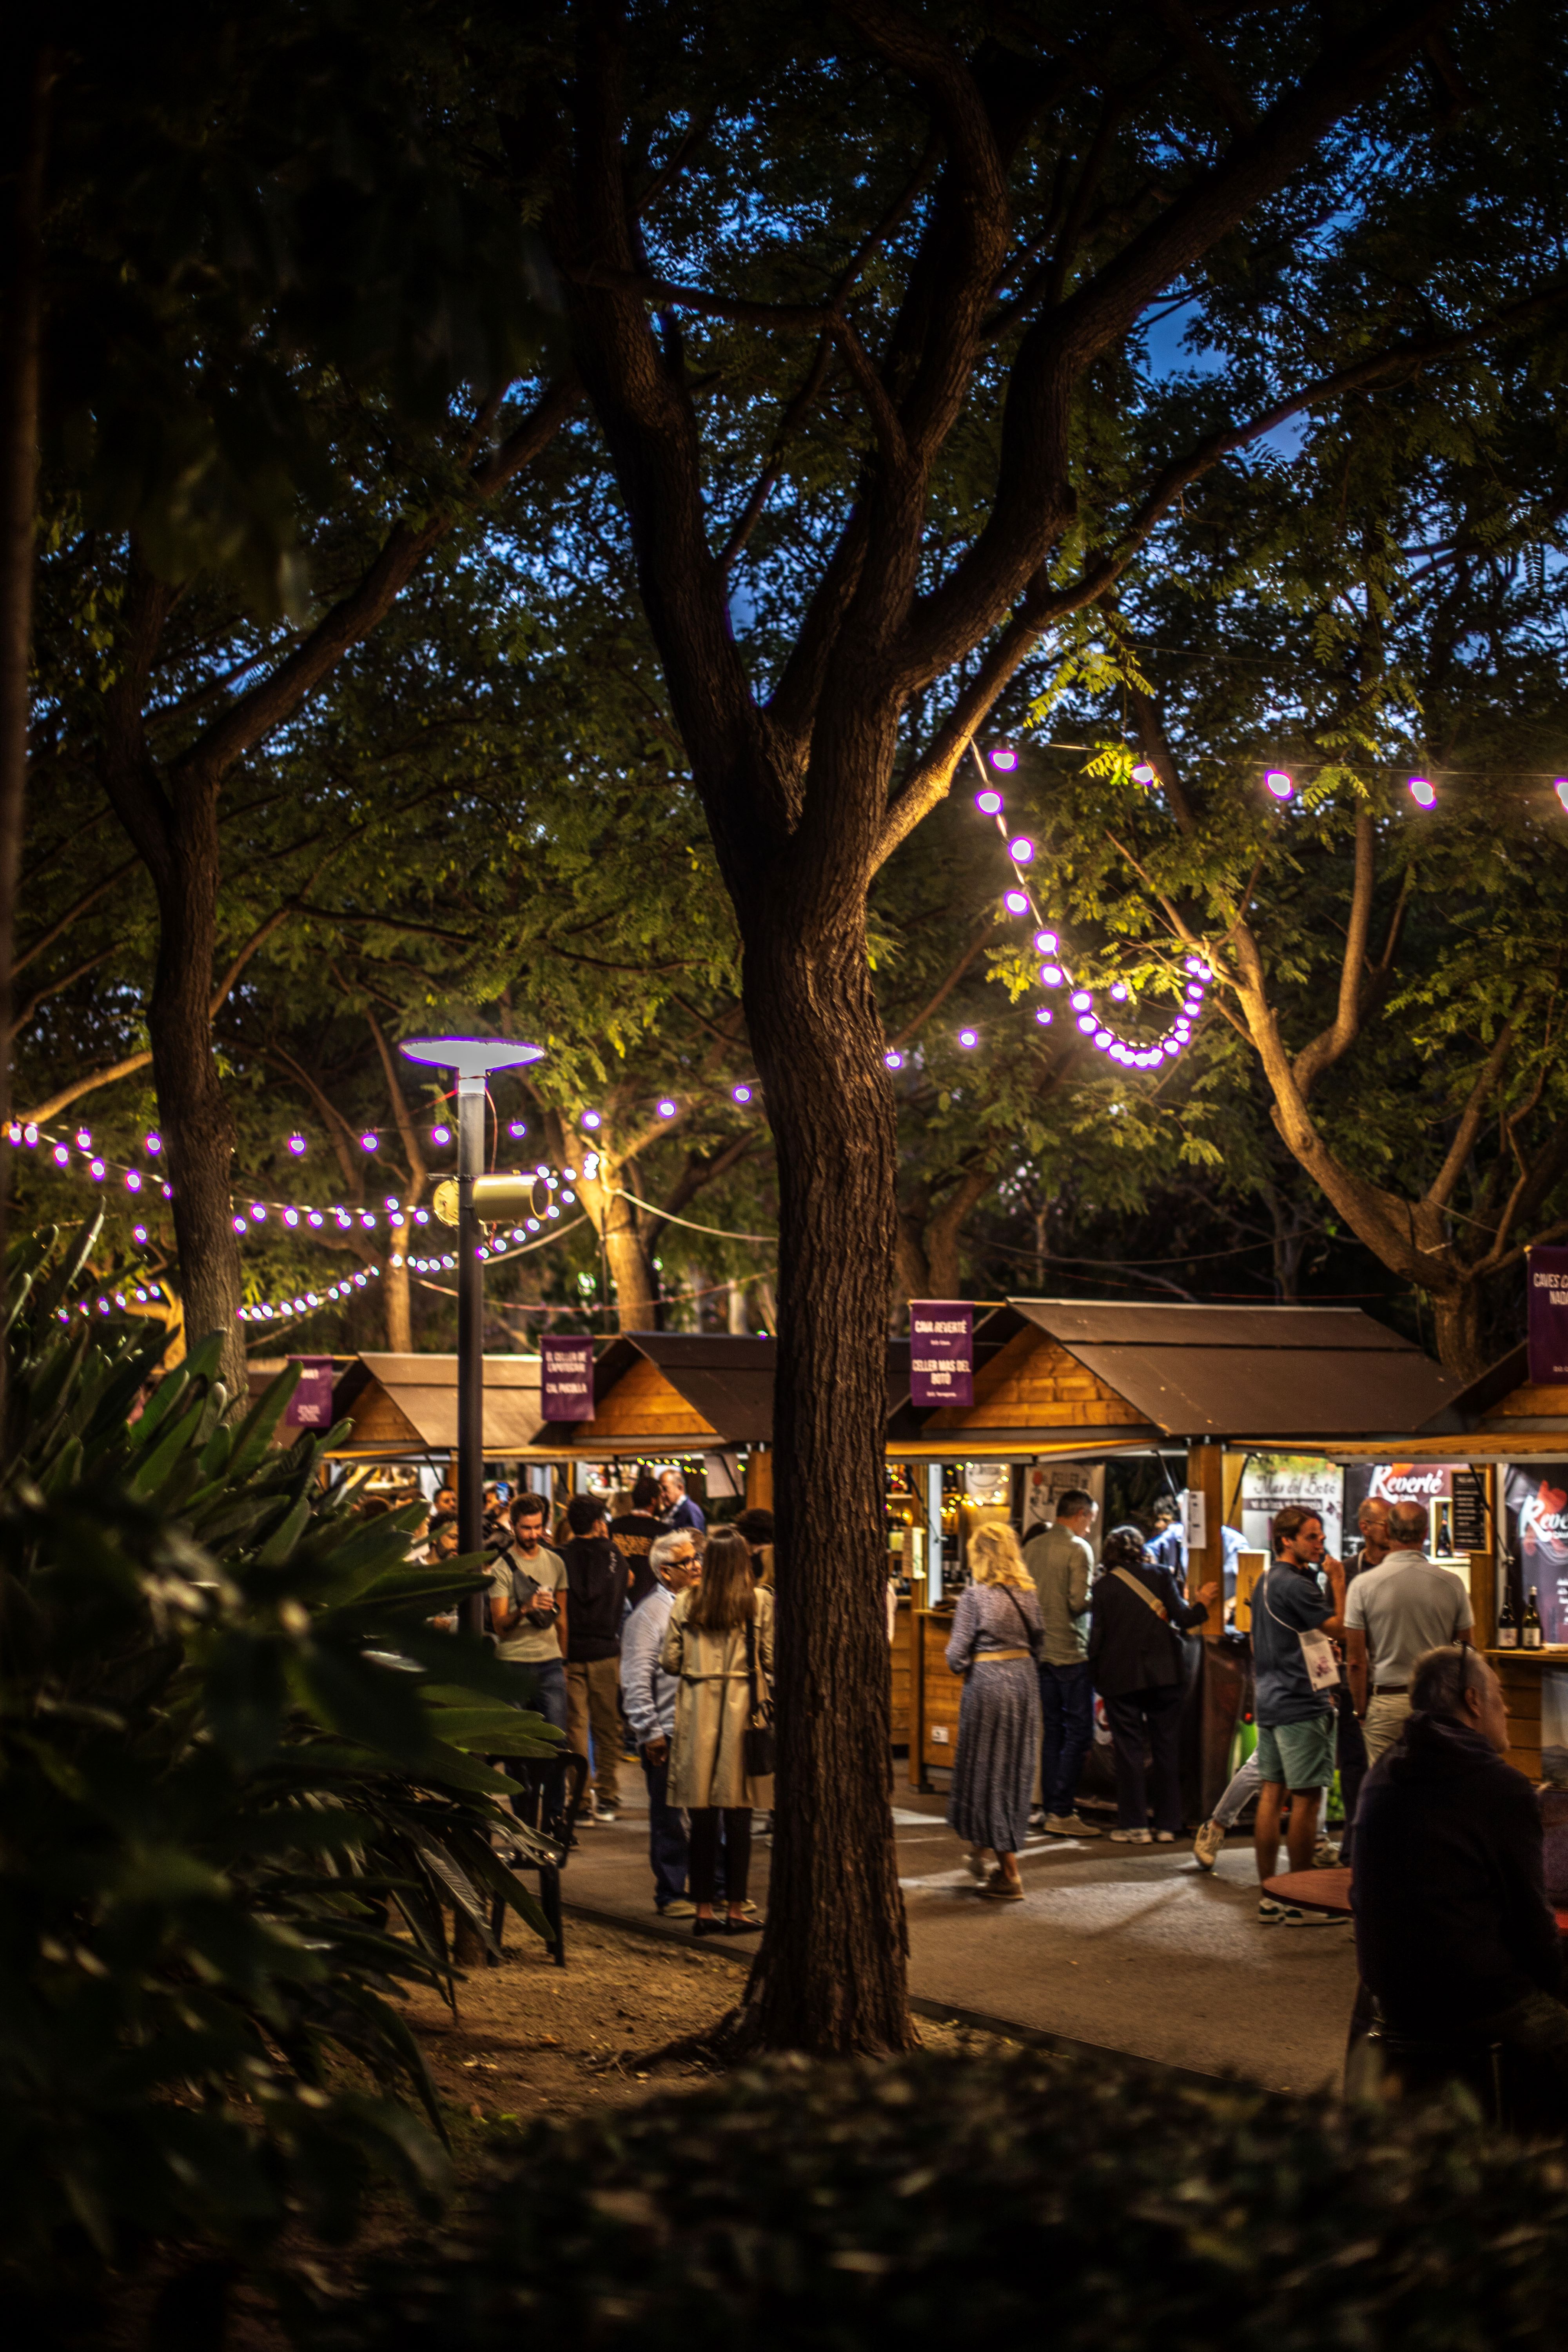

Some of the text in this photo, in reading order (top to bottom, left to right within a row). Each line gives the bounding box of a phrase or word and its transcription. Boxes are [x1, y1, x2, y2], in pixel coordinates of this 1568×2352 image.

[1533, 1272, 1560, 1289] CAVES
[915, 1319, 967, 1334] CAVA REVERTÉ
[912, 1359, 971, 1372] CELLER MAS DEL
[1368, 1465, 1444, 1504] Reverté
